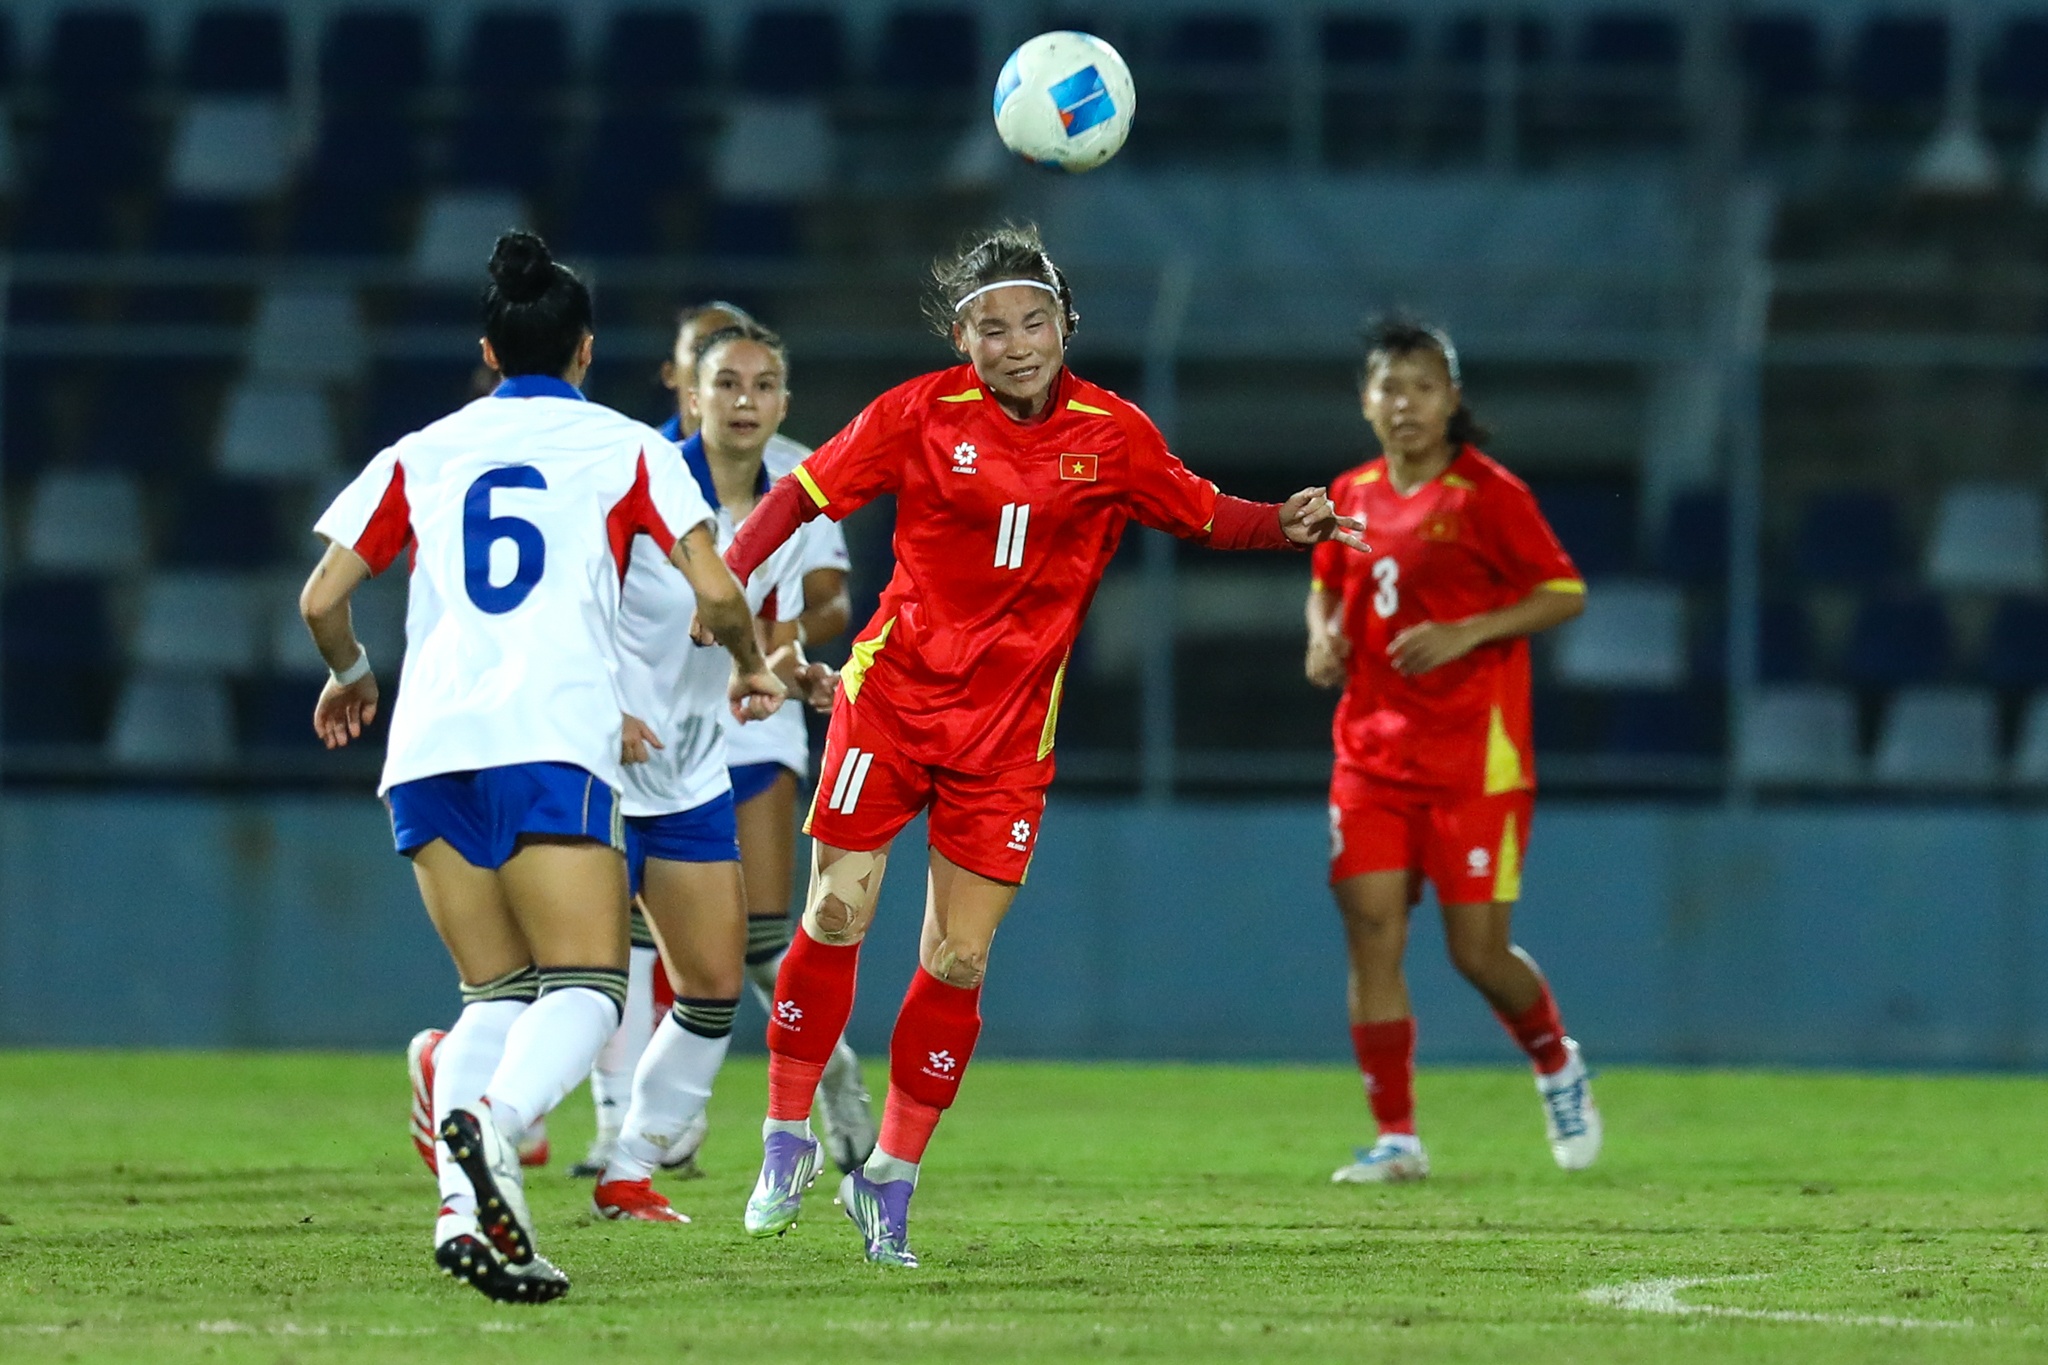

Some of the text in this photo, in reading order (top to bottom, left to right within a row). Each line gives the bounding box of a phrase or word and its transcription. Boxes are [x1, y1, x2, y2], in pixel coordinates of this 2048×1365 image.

[463, 465, 548, 615] 6
[994, 502, 1030, 570] 11
[1372, 556, 1399, 618] 3
[828, 747, 874, 815] 11
